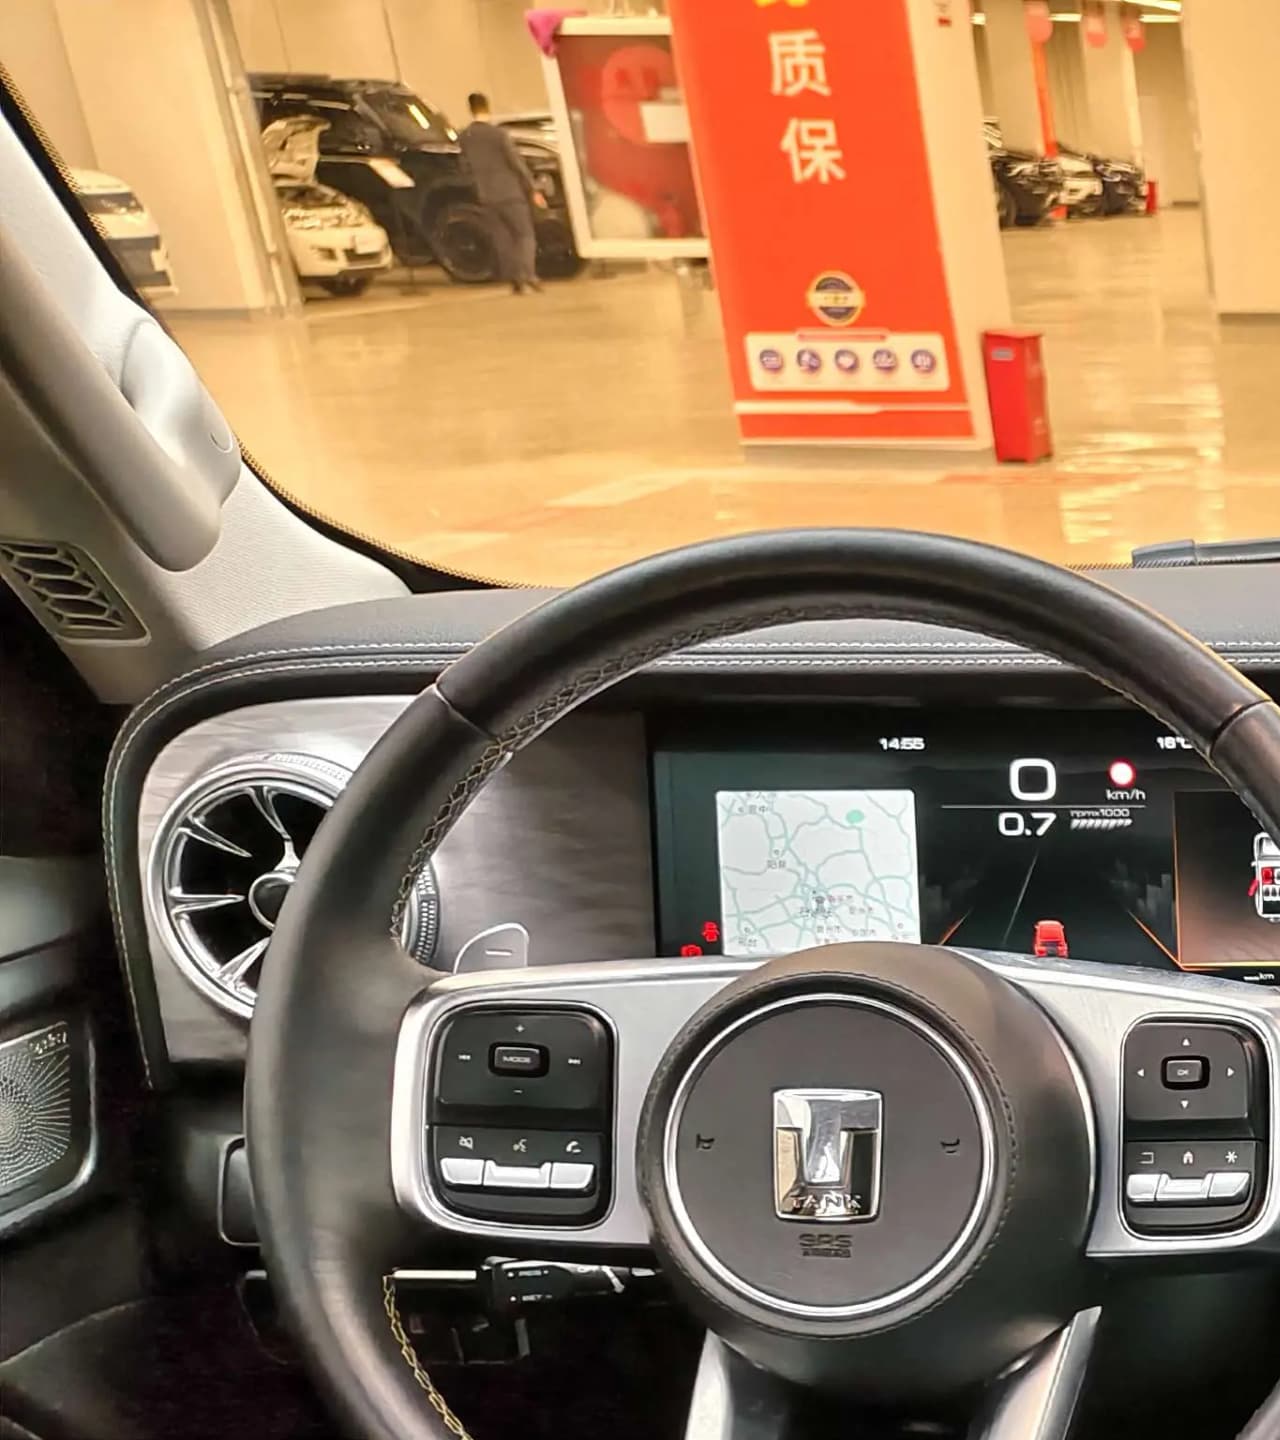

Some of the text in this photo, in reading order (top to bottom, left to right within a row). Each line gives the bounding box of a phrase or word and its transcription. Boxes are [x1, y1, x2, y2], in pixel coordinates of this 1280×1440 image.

[755, 0, 847, 183] 质保
[1009, 758, 1057, 801] 0
[1105, 788, 1146, 800] km/h
[998, 812, 1057, 836] 0.7
[502, 1055, 531, 1064] MODE
[790, 1194, 862, 1210] TANK
